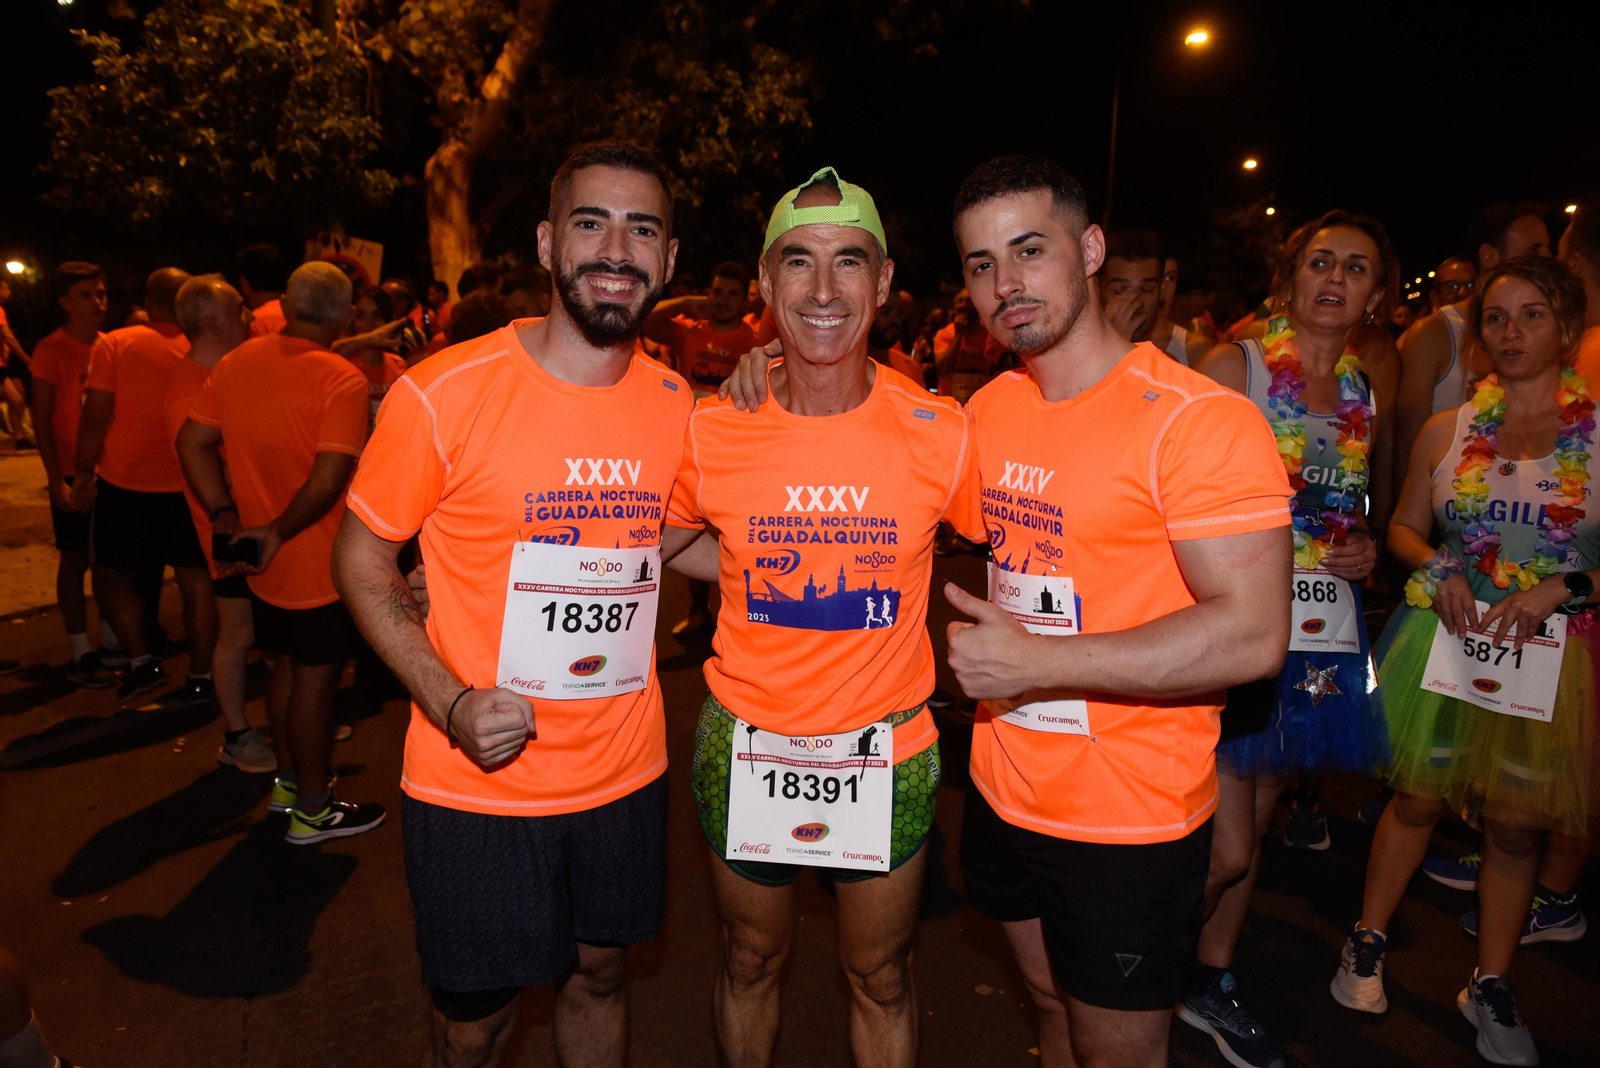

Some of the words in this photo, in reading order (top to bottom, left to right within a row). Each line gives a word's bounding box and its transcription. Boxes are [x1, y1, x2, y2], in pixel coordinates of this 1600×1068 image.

[564, 458, 642, 486] XXXV
[997, 460, 1056, 496] XXXV
[524, 490, 595, 504] CARRERA
[600, 490, 662, 503] NOCTURNA
[784, 485, 870, 512] XXXV
[525, 505, 533, 523] DEL
[536, 504, 662, 521] GUADALQUIVIR
[1016, 496, 1063, 518] NOCTURNA
[749, 515, 814, 527] CARRERA
[820, 516, 898, 528] NOCTURNA
[982, 501, 1063, 537] GUADALQUIVIR
[757, 530, 898, 545] GUADALQUIVIR
[536, 585, 564, 593] CARRERA
[607, 587, 638, 595] GUADALQUIVIR
[541, 601, 640, 633] 18387
[748, 612, 770, 622] 2023
[1463, 636, 1523, 669] 5871
[615, 674, 643, 687] Cruzcampo
[1510, 702, 1545, 714] Cruzcampo
[1037, 713, 1080, 726] Cruzcampo
[756, 755, 781, 763] CARRERA
[781, 758, 810, 767] NOCTURNA
[820, 760, 859, 769] GUADALQUIVIR
[762, 769, 858, 804] 18391
[842, 851, 882, 862] Cruzcampo
